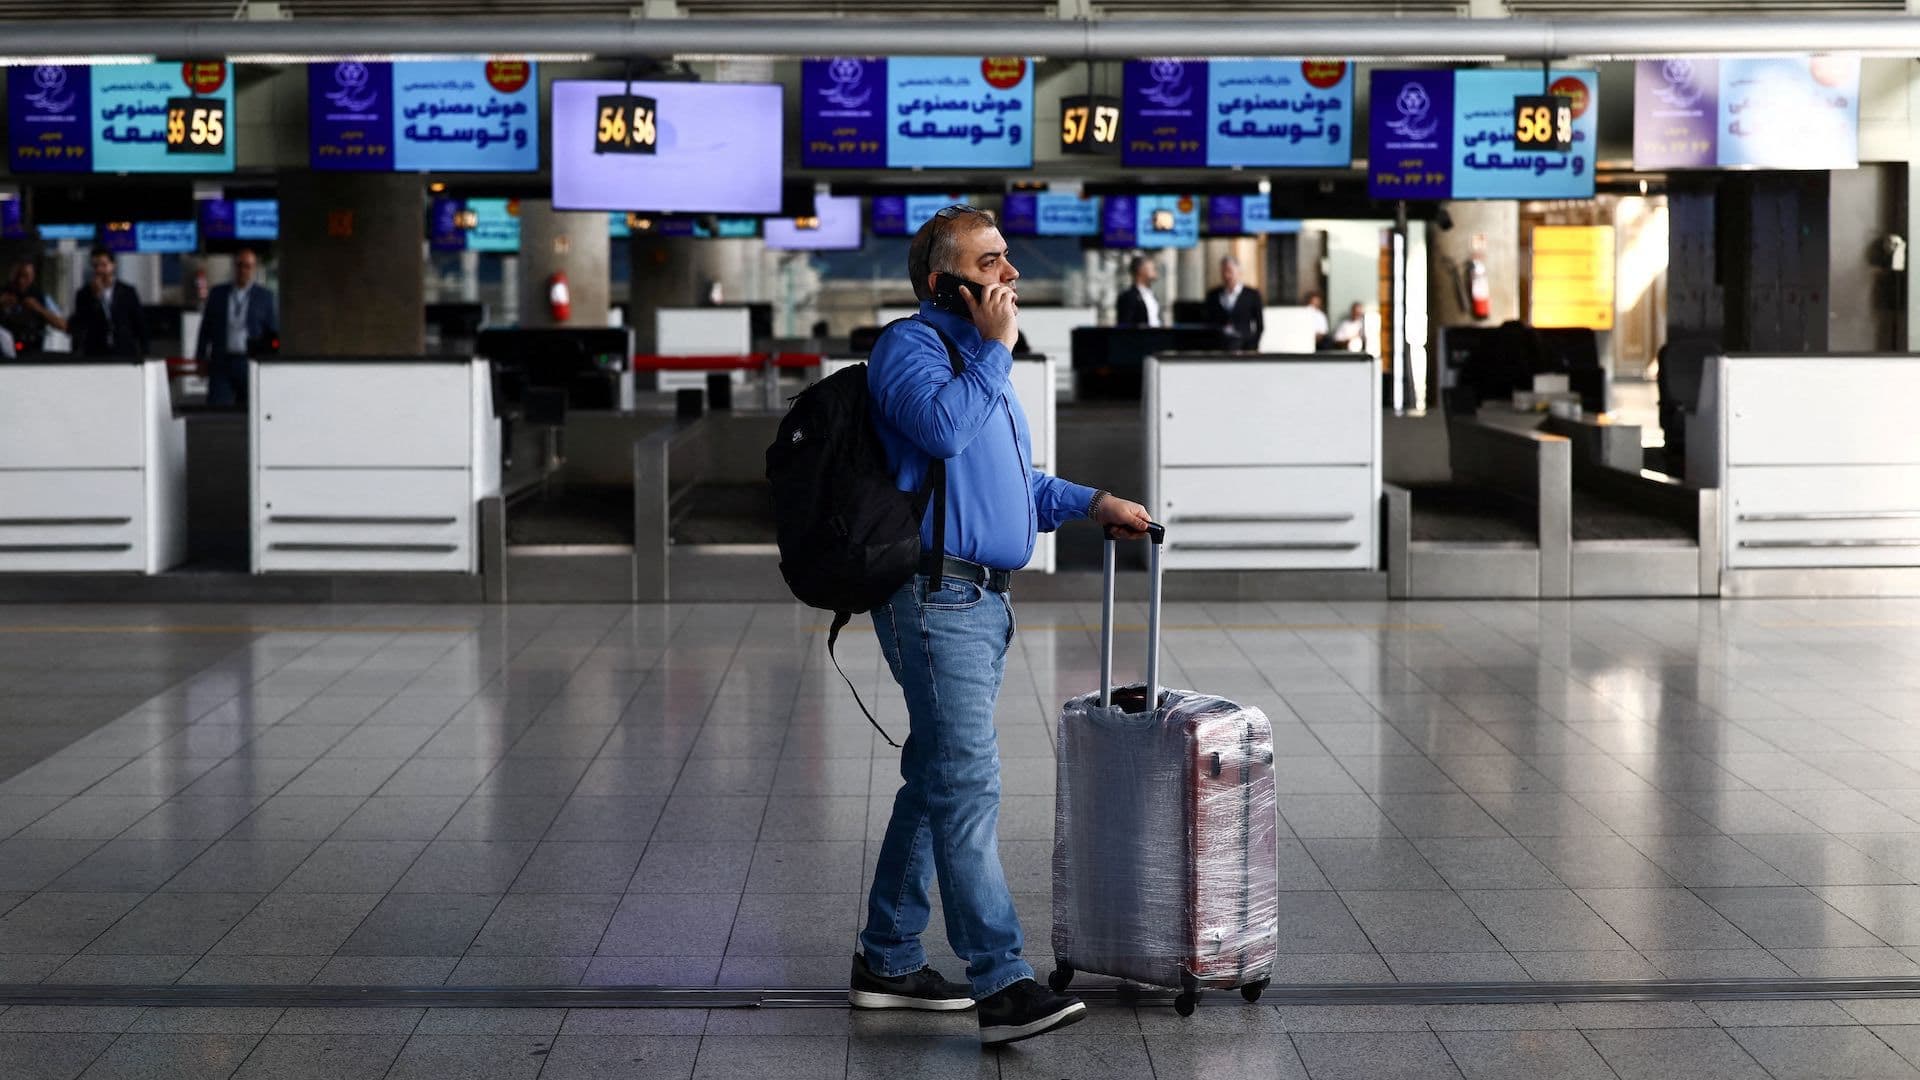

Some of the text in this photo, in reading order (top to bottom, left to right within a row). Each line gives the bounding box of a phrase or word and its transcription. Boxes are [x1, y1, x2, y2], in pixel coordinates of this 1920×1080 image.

[402, 96, 527, 120] هوش مصنوعی
[898, 92, 1022, 116] هوش مصنوعی
[1218, 92, 1342, 115] هوش مصنوعی
[167, 108, 185, 145] 55
[190, 108, 223, 145] 55
[404, 120, 527, 149] و توسعه
[598, 106, 627, 144] 56
[632, 110, 656, 146] 56
[898, 117, 1022, 146] و توسعه
[1062, 106, 1089, 144] 57
[1093, 105, 1119, 143] 57
[1218, 116, 1341, 144] و توسعه
[1517, 106, 1552, 143] 58
[1556, 106, 1573, 144] 58
[1571, 155, 1585, 176] و
